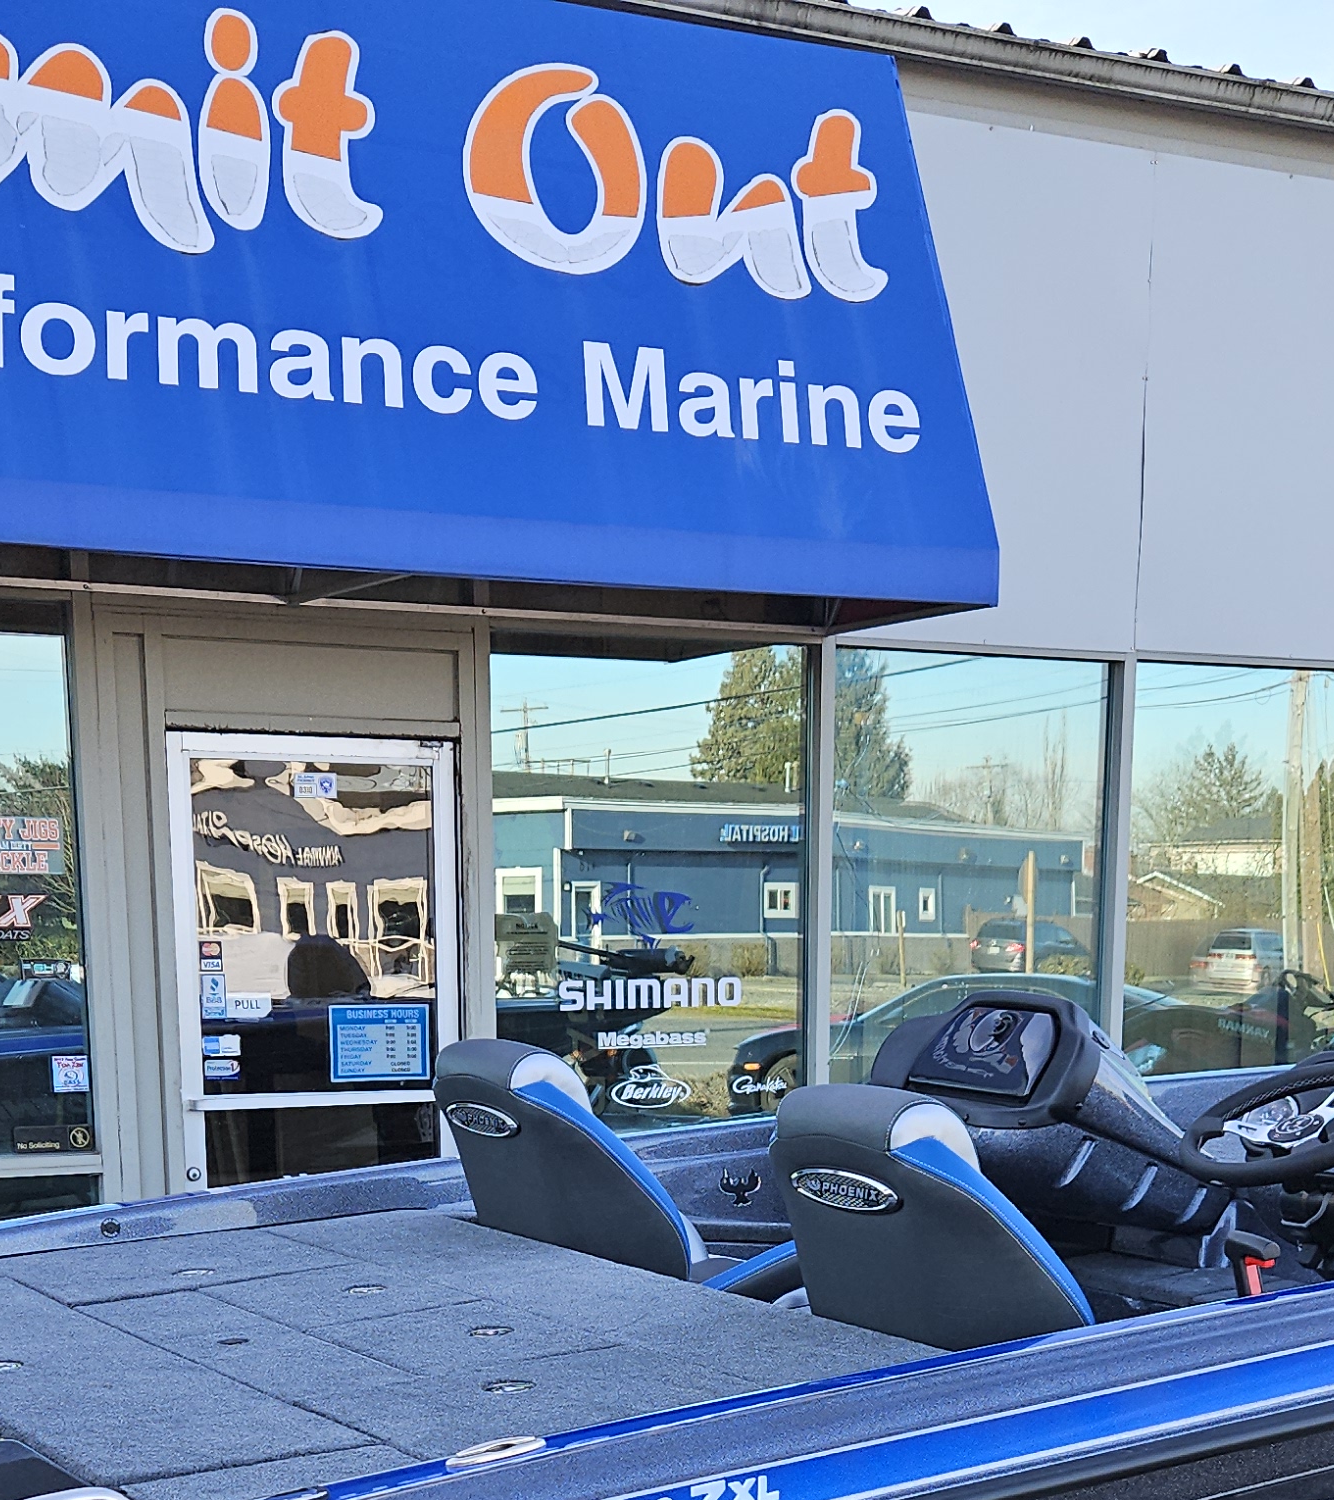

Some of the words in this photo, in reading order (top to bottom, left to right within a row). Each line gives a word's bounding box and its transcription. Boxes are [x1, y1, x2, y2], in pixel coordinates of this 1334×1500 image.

[463, 62, 889, 302] Out
[582, 340, 921, 454] Marine
[19, 817, 60, 840] JIGS
[203, 961, 221, 969] VISA
[558, 976, 742, 1012] SHIMANO
[234, 999, 262, 1010] PULL
[347, 1009, 389, 1019] BUSINESS
[391, 1009, 420, 1019] HOURS
[597, 1030, 707, 1049] Megabass
[620, 1083, 683, 1102] Berkley
[16, 1142, 27, 1150] No
[821, 1182, 878, 1201] PHOENIX
